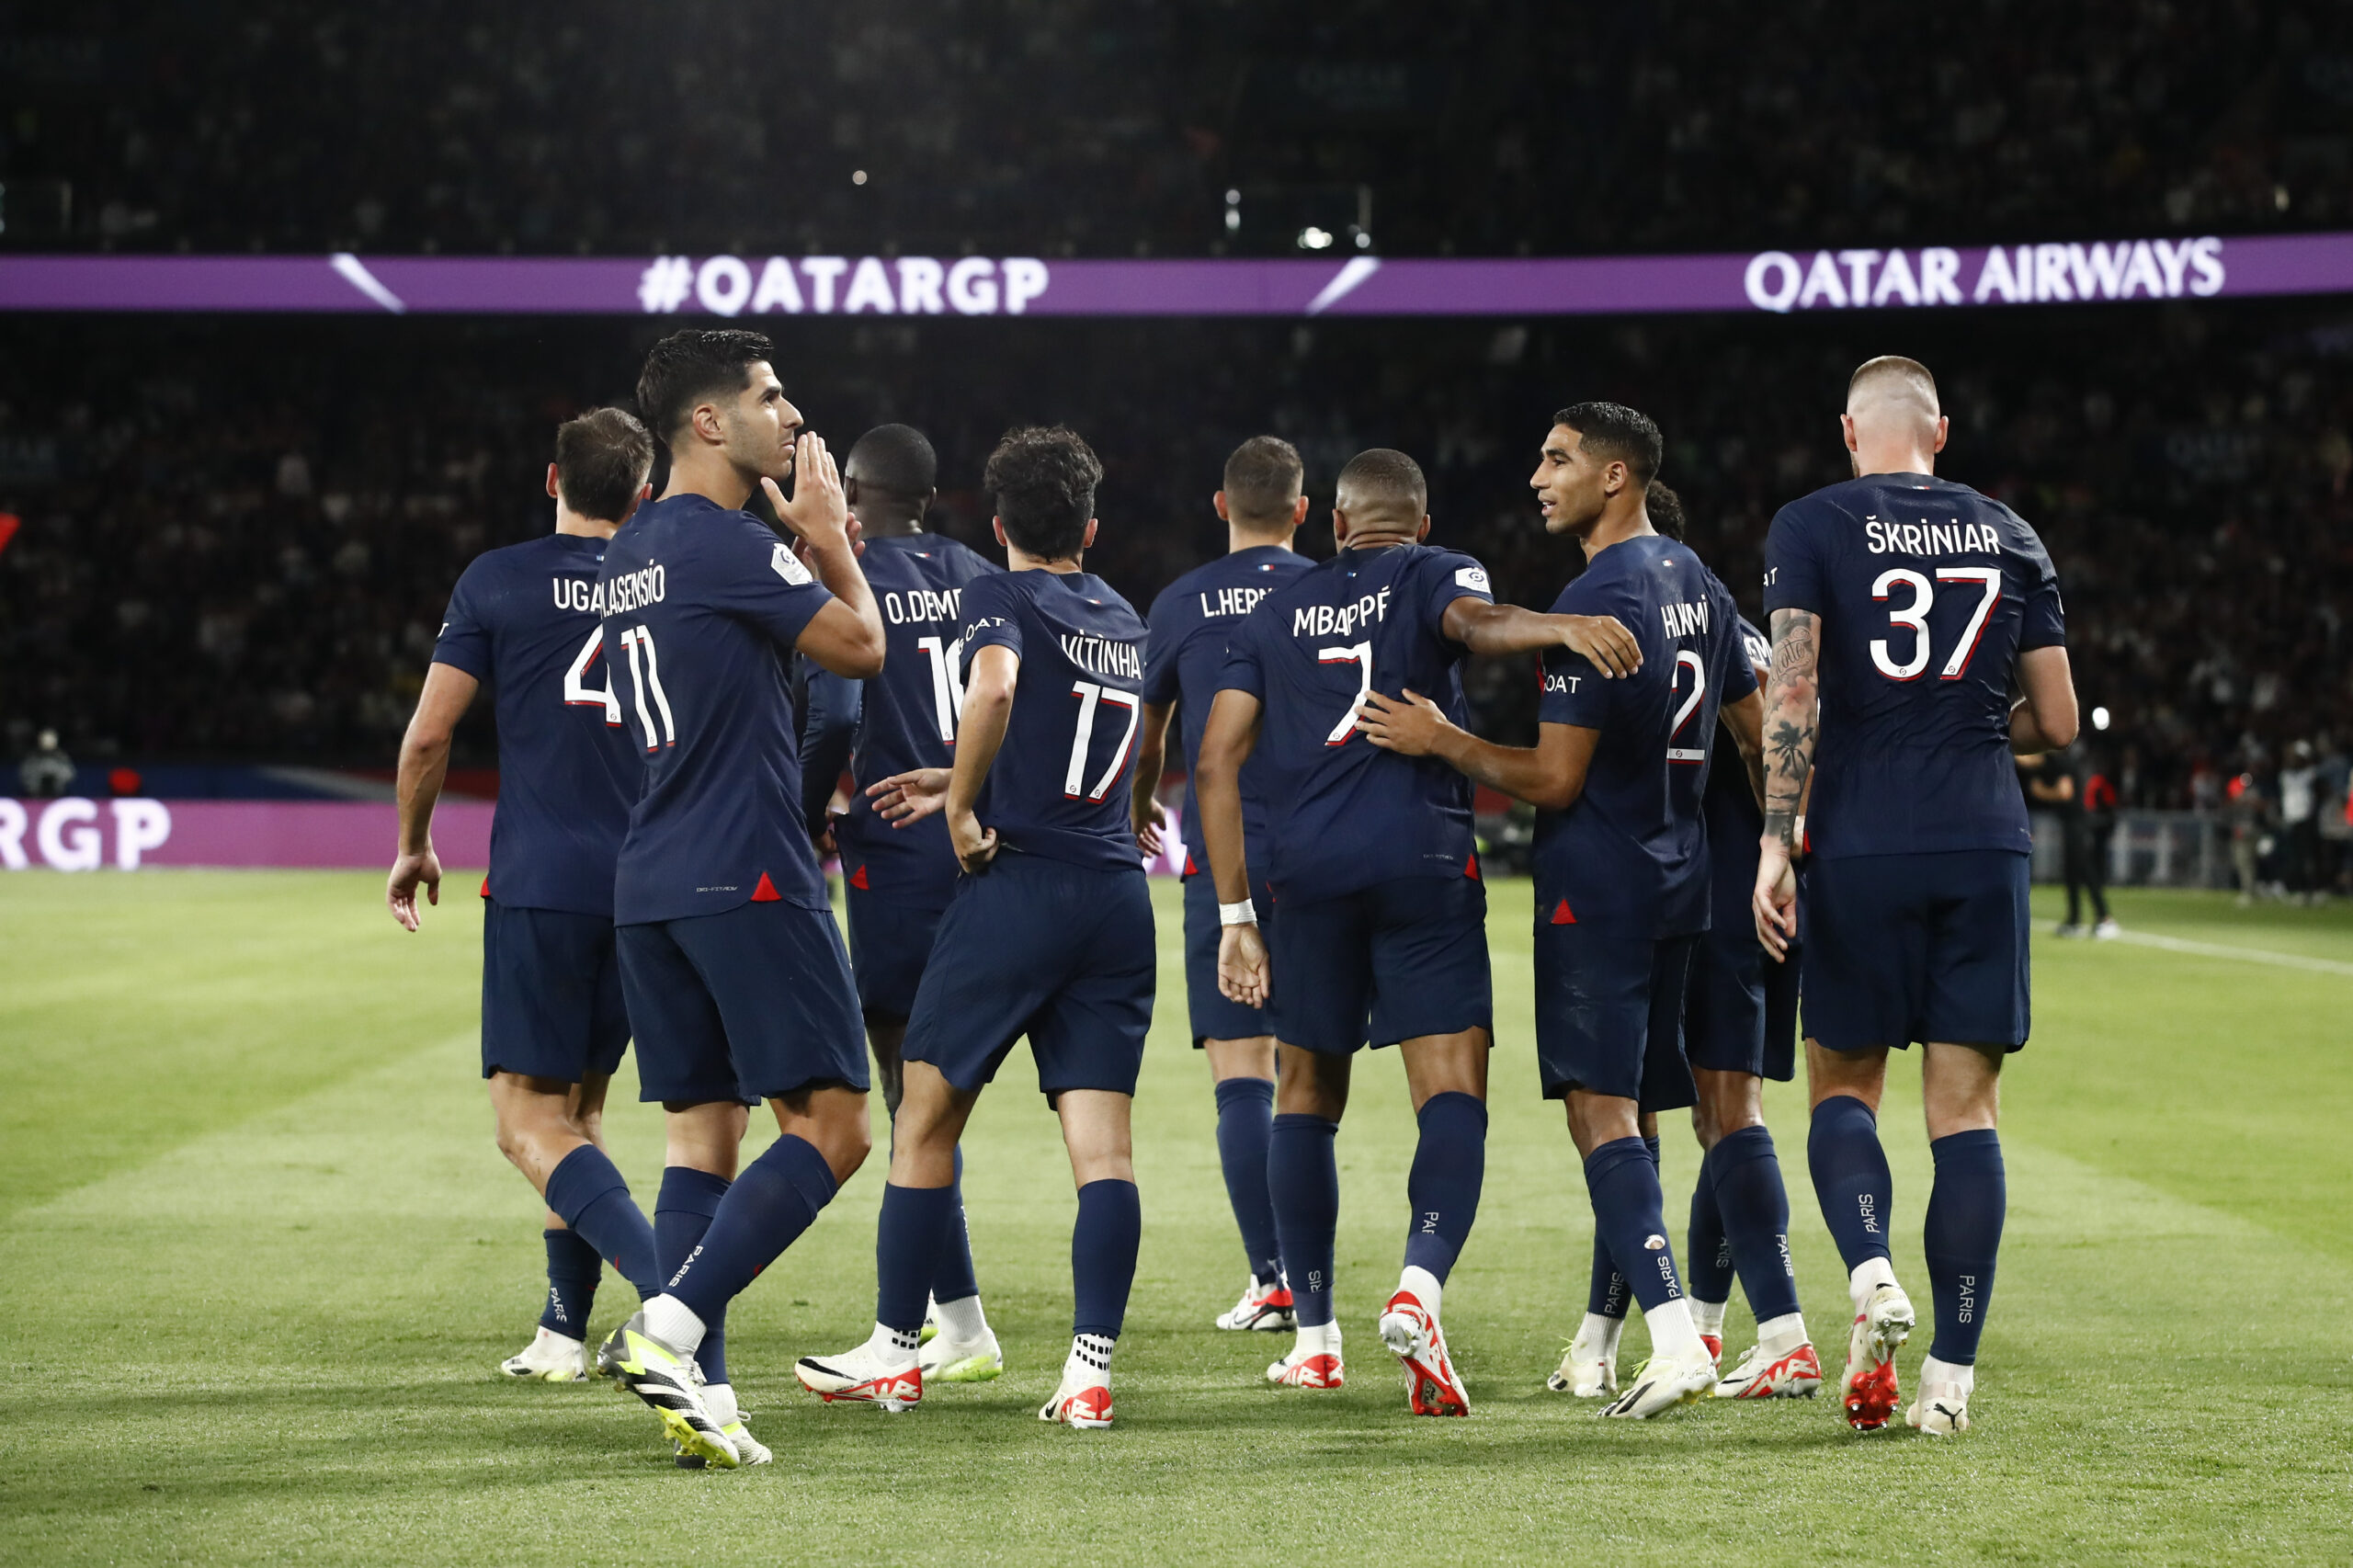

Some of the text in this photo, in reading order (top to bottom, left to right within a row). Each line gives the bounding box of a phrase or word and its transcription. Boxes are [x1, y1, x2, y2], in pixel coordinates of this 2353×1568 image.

[638, 255, 1050, 317] #QATARGP
[1745, 236, 2225, 313] QATAR AIRWAYS
[1870, 567, 2002, 681] 37
[564, 623, 622, 727] 4
[620, 625, 676, 753] 11
[1318, 640, 1373, 746] 7
[1543, 674, 1582, 694] OAT
[1666, 650, 1706, 765] 2
[1064, 680, 1140, 805] 17
[1859, 1194, 1881, 1233] PARIS
[668, 1245, 704, 1288] PARIS
[1657, 1256, 1681, 1298] PARIS
[1775, 1233, 1794, 1277] PARIS
[550, 1287, 567, 1323] PARIS
[1604, 1272, 1624, 1314] PARIS
[1959, 1275, 1975, 1324] PARIS
